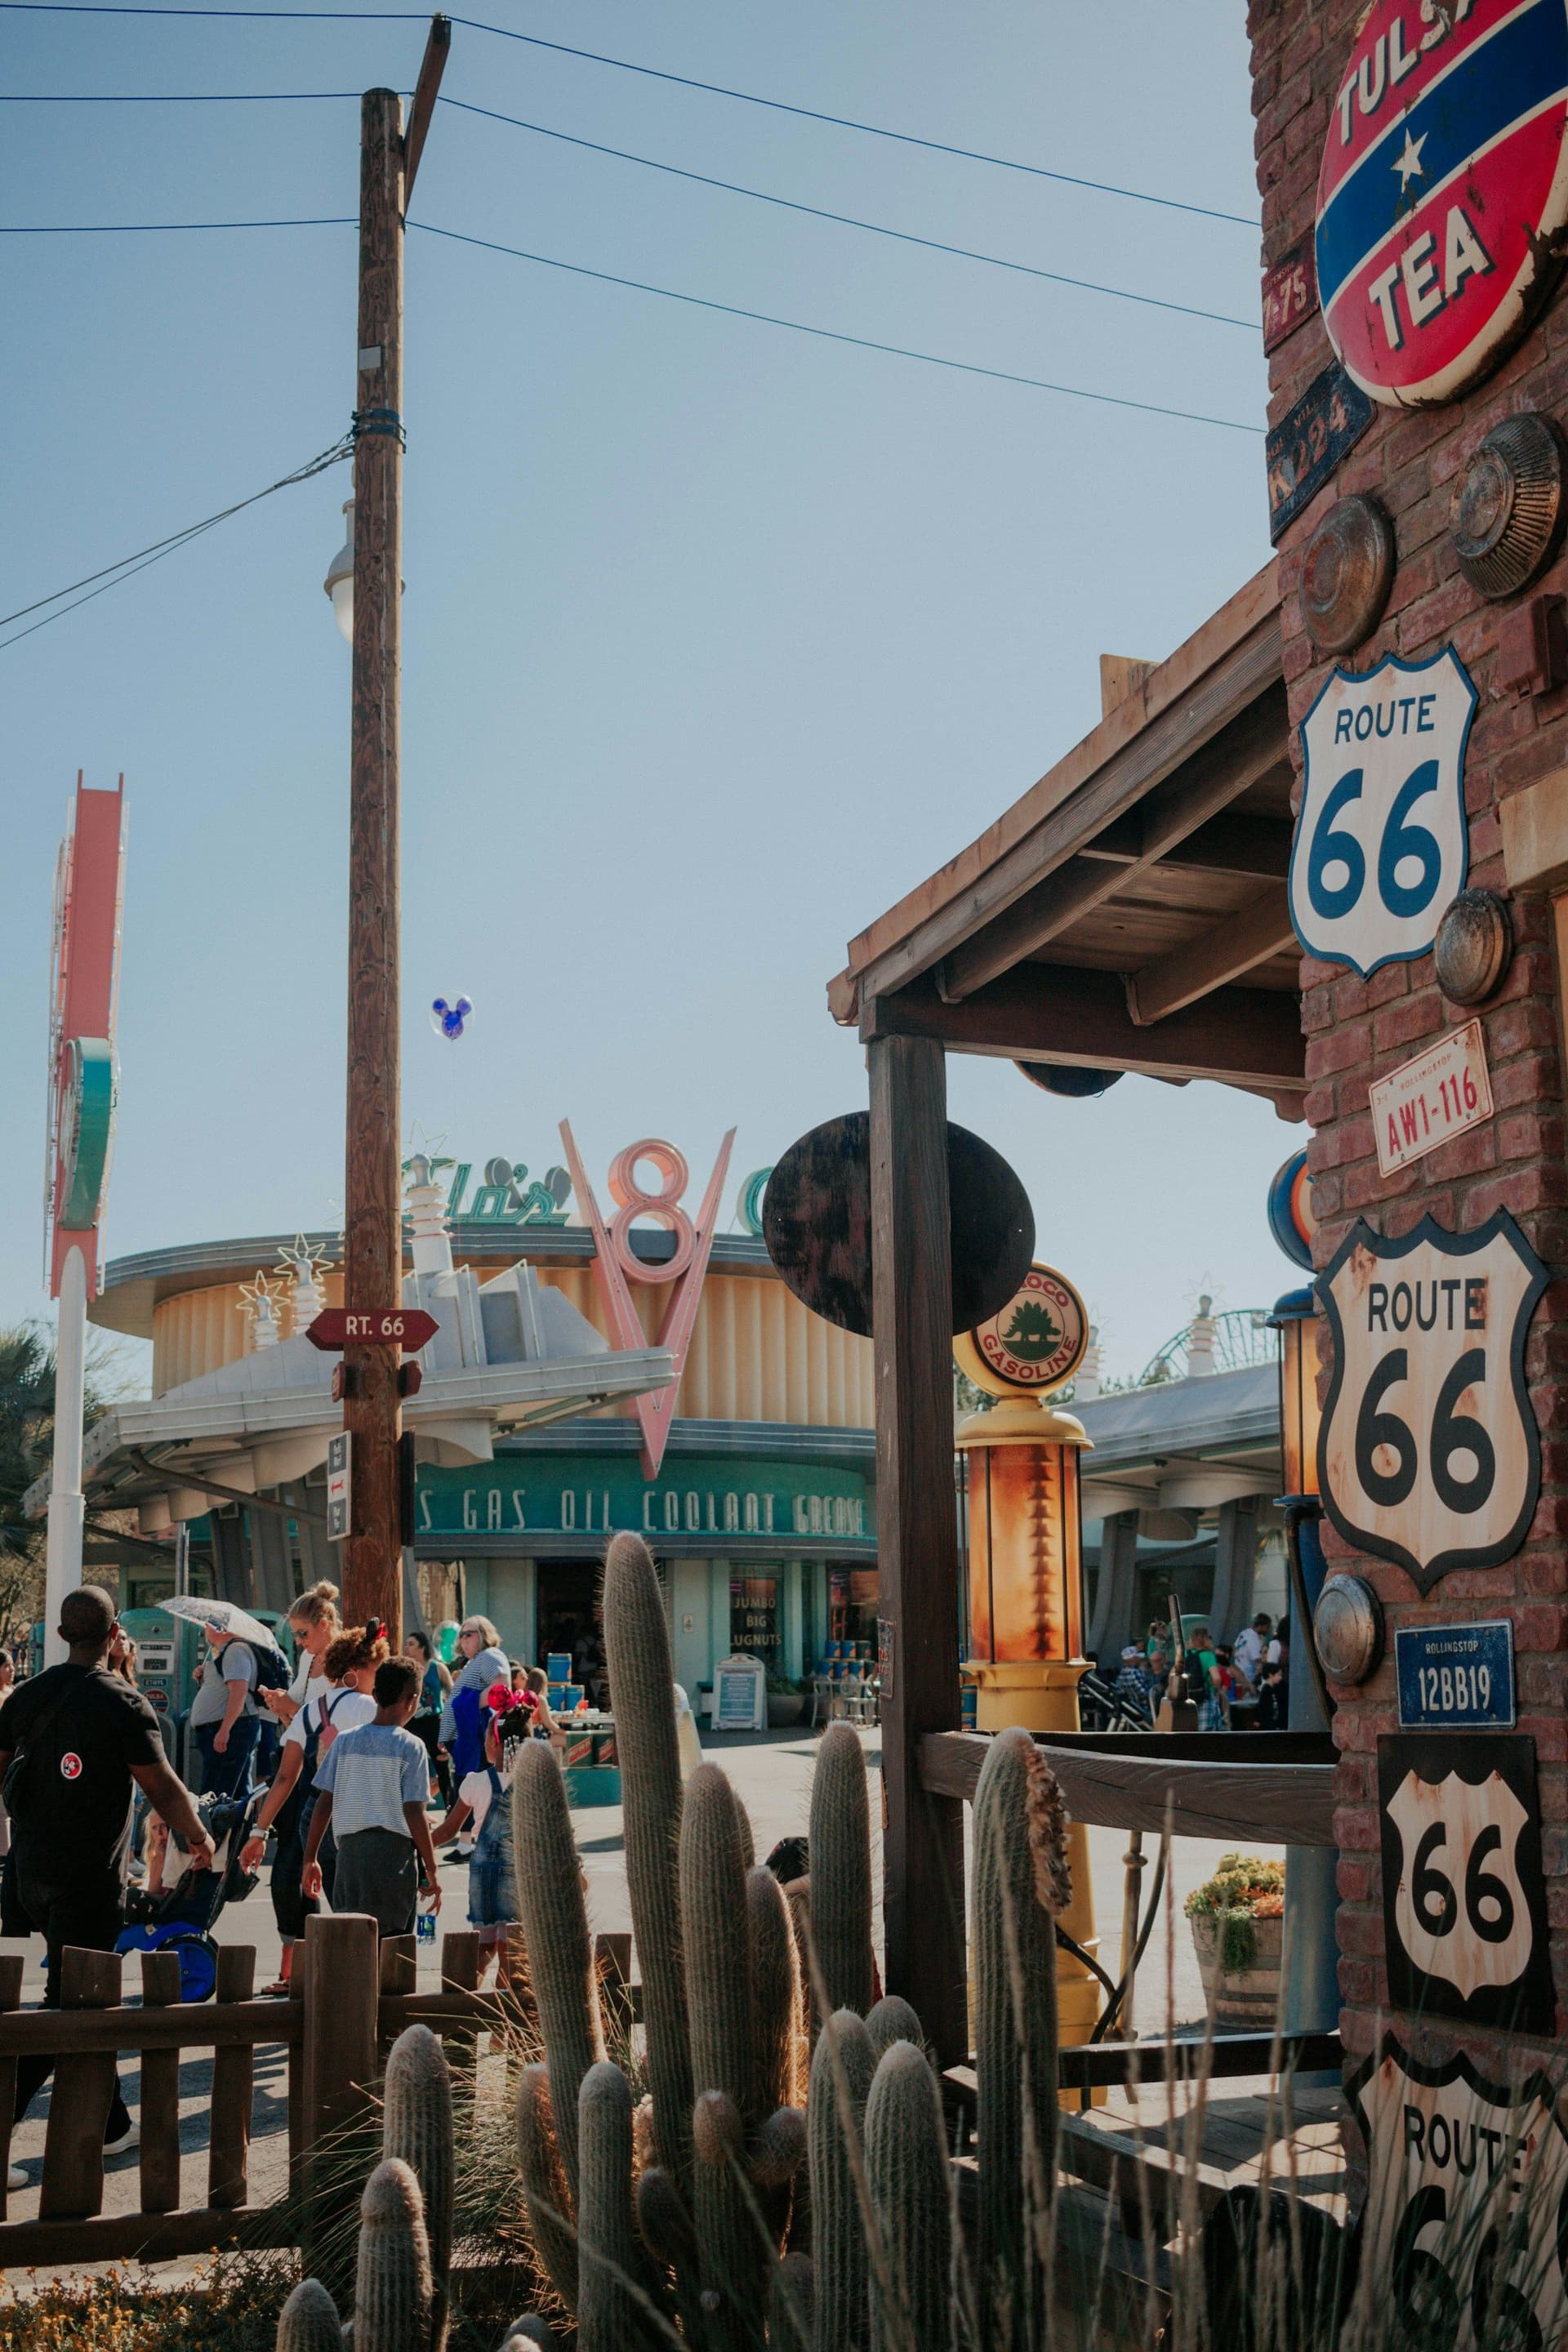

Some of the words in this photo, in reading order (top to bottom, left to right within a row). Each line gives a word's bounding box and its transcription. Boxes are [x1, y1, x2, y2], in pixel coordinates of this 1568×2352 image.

[1337, 0, 1475, 147] TULS
[1369, 205, 1492, 350] TEA
[1335, 693, 1436, 744] ROUTE
[1307, 760, 1441, 920] 66
[1022, 1275, 1069, 1307] OCO
[1369, 1277, 1486, 1332] ROUTE
[346, 1316, 372, 1334] RT.
[381, 1316, 404, 1336] 66
[982, 1334, 1078, 1379] GASOLINE
[1355, 1348, 1496, 1515] 66
[463, 1490, 525, 1530] GAS
[561, 1490, 612, 1530] OIL
[644, 1491, 775, 1532] COOLANT
[793, 1494, 865, 1535] GREASE
[734, 1597, 776, 1609] JUMBO
[746, 1615, 767, 1628] BIG
[1425, 1640, 1479, 1655] ROLLINGSTOP
[1418, 1664, 1491, 1712] 12BB19
[1412, 1821, 1514, 1944] 66
[1404, 2104, 1528, 2194] ROUTE
